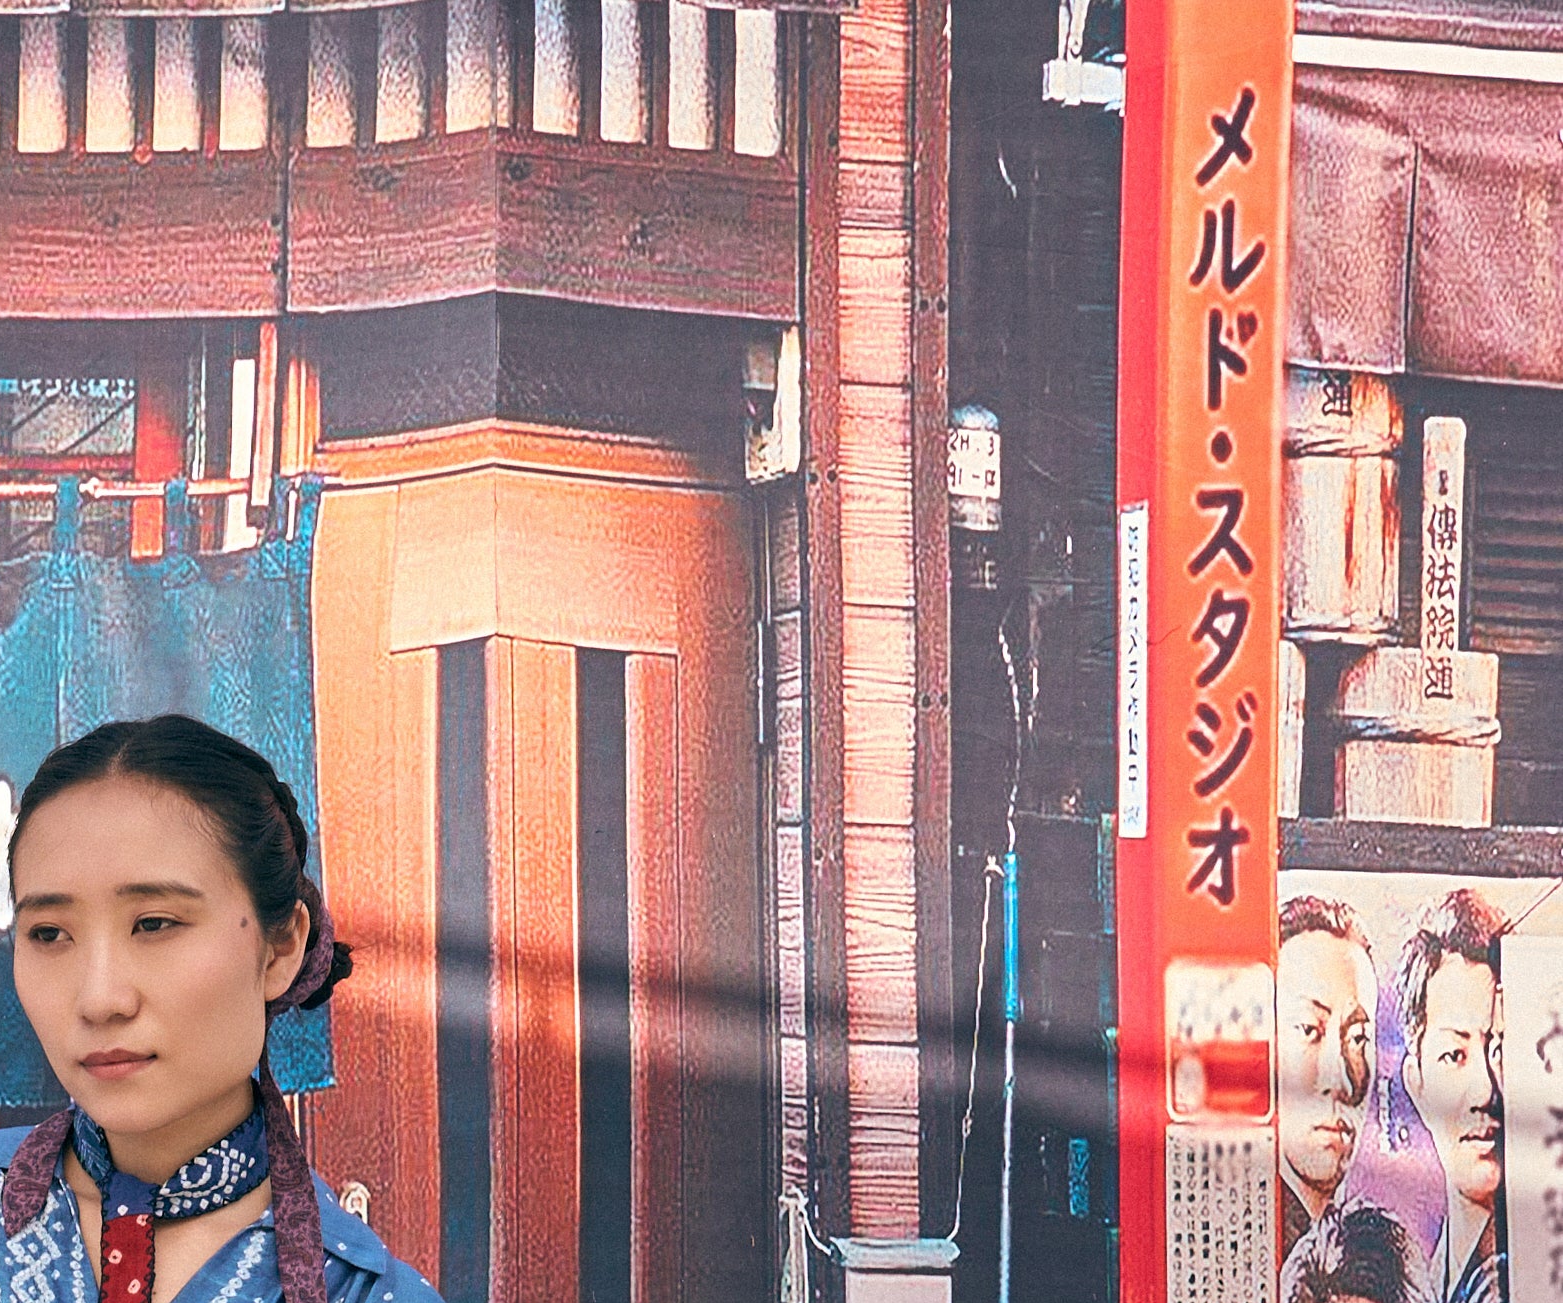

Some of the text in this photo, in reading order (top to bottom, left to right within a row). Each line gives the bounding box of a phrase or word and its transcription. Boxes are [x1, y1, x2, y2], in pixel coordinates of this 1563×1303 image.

[1187, 88, 1265, 906] メルド・スタジオ
